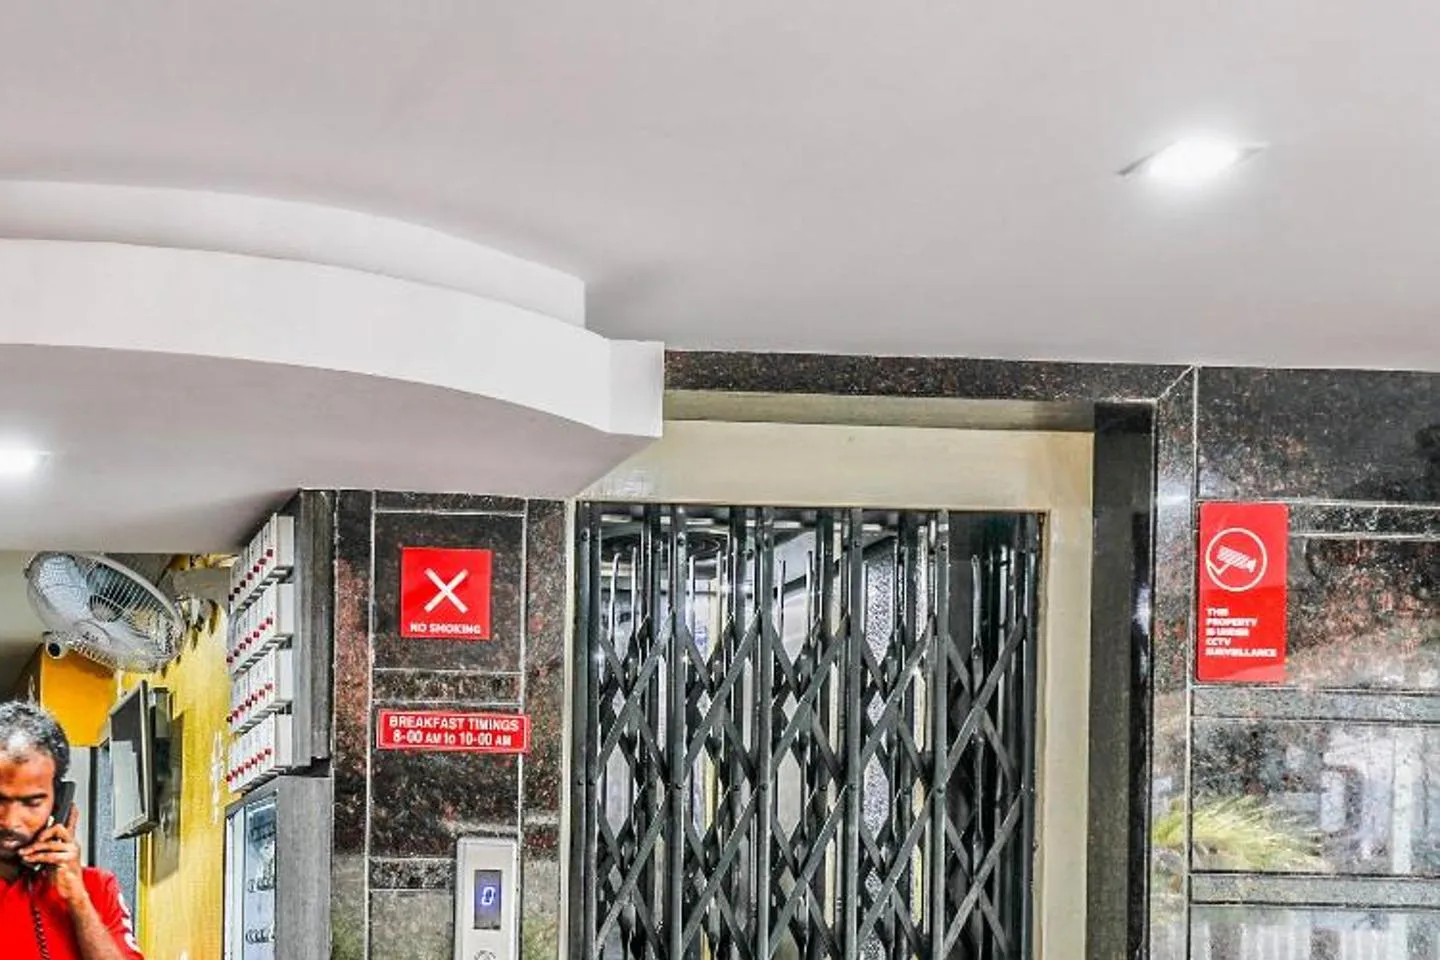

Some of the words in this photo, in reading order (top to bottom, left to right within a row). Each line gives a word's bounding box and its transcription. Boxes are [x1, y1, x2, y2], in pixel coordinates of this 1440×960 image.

[1206, 617, 1258, 627] PROPERTY
[410, 623, 427, 633] NO
[429, 623, 481, 634] SMOKING
[1206, 637, 1231, 647] CCTV
[389, 715, 464, 731] BREAKFAST
[468, 718, 519, 731] TIMINGS
[425, 732, 441, 743] AM
[444, 732, 456, 744] to
[495, 735, 512, 746] AM
